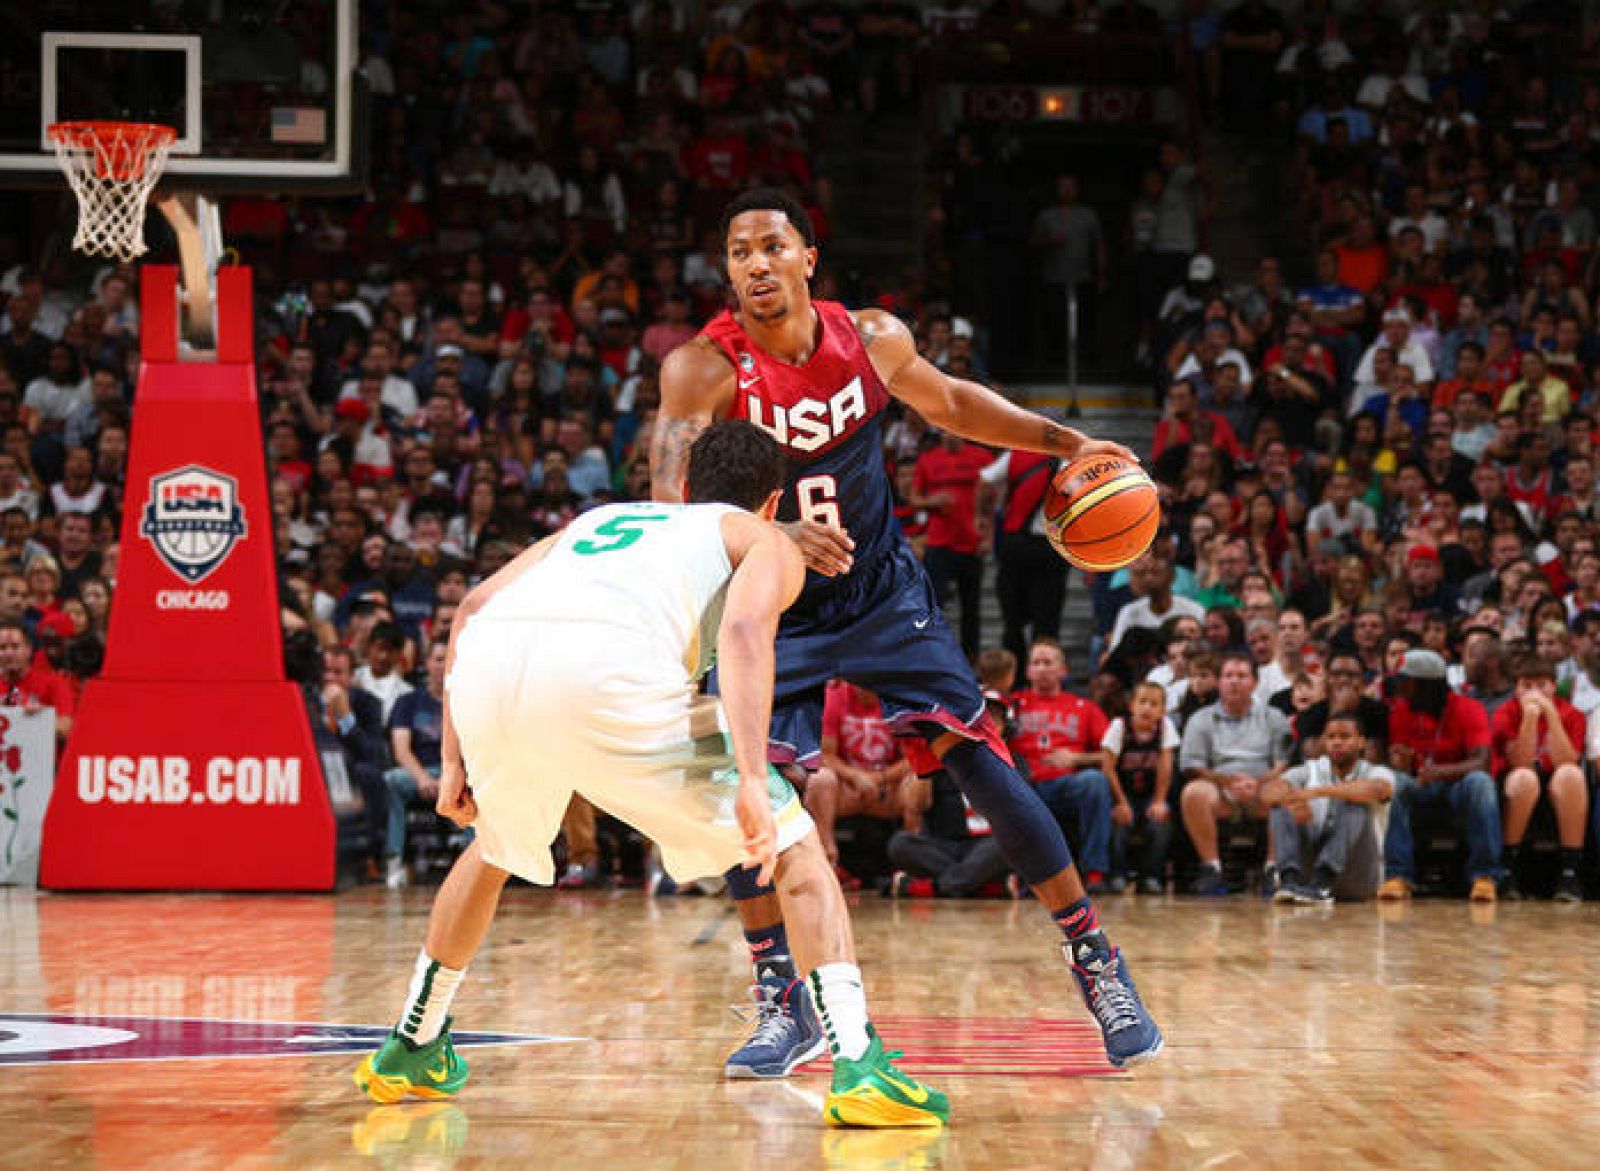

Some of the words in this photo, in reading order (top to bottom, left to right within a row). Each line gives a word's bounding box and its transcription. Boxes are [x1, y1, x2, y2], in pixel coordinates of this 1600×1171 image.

[749, 376, 867, 452] USA
[163, 484, 223, 513] USA
[798, 475, 841, 530] 6
[572, 514, 668, 555] 5
[157, 590, 230, 611] CHICAGO
[78, 756, 301, 805] USAB.COM
